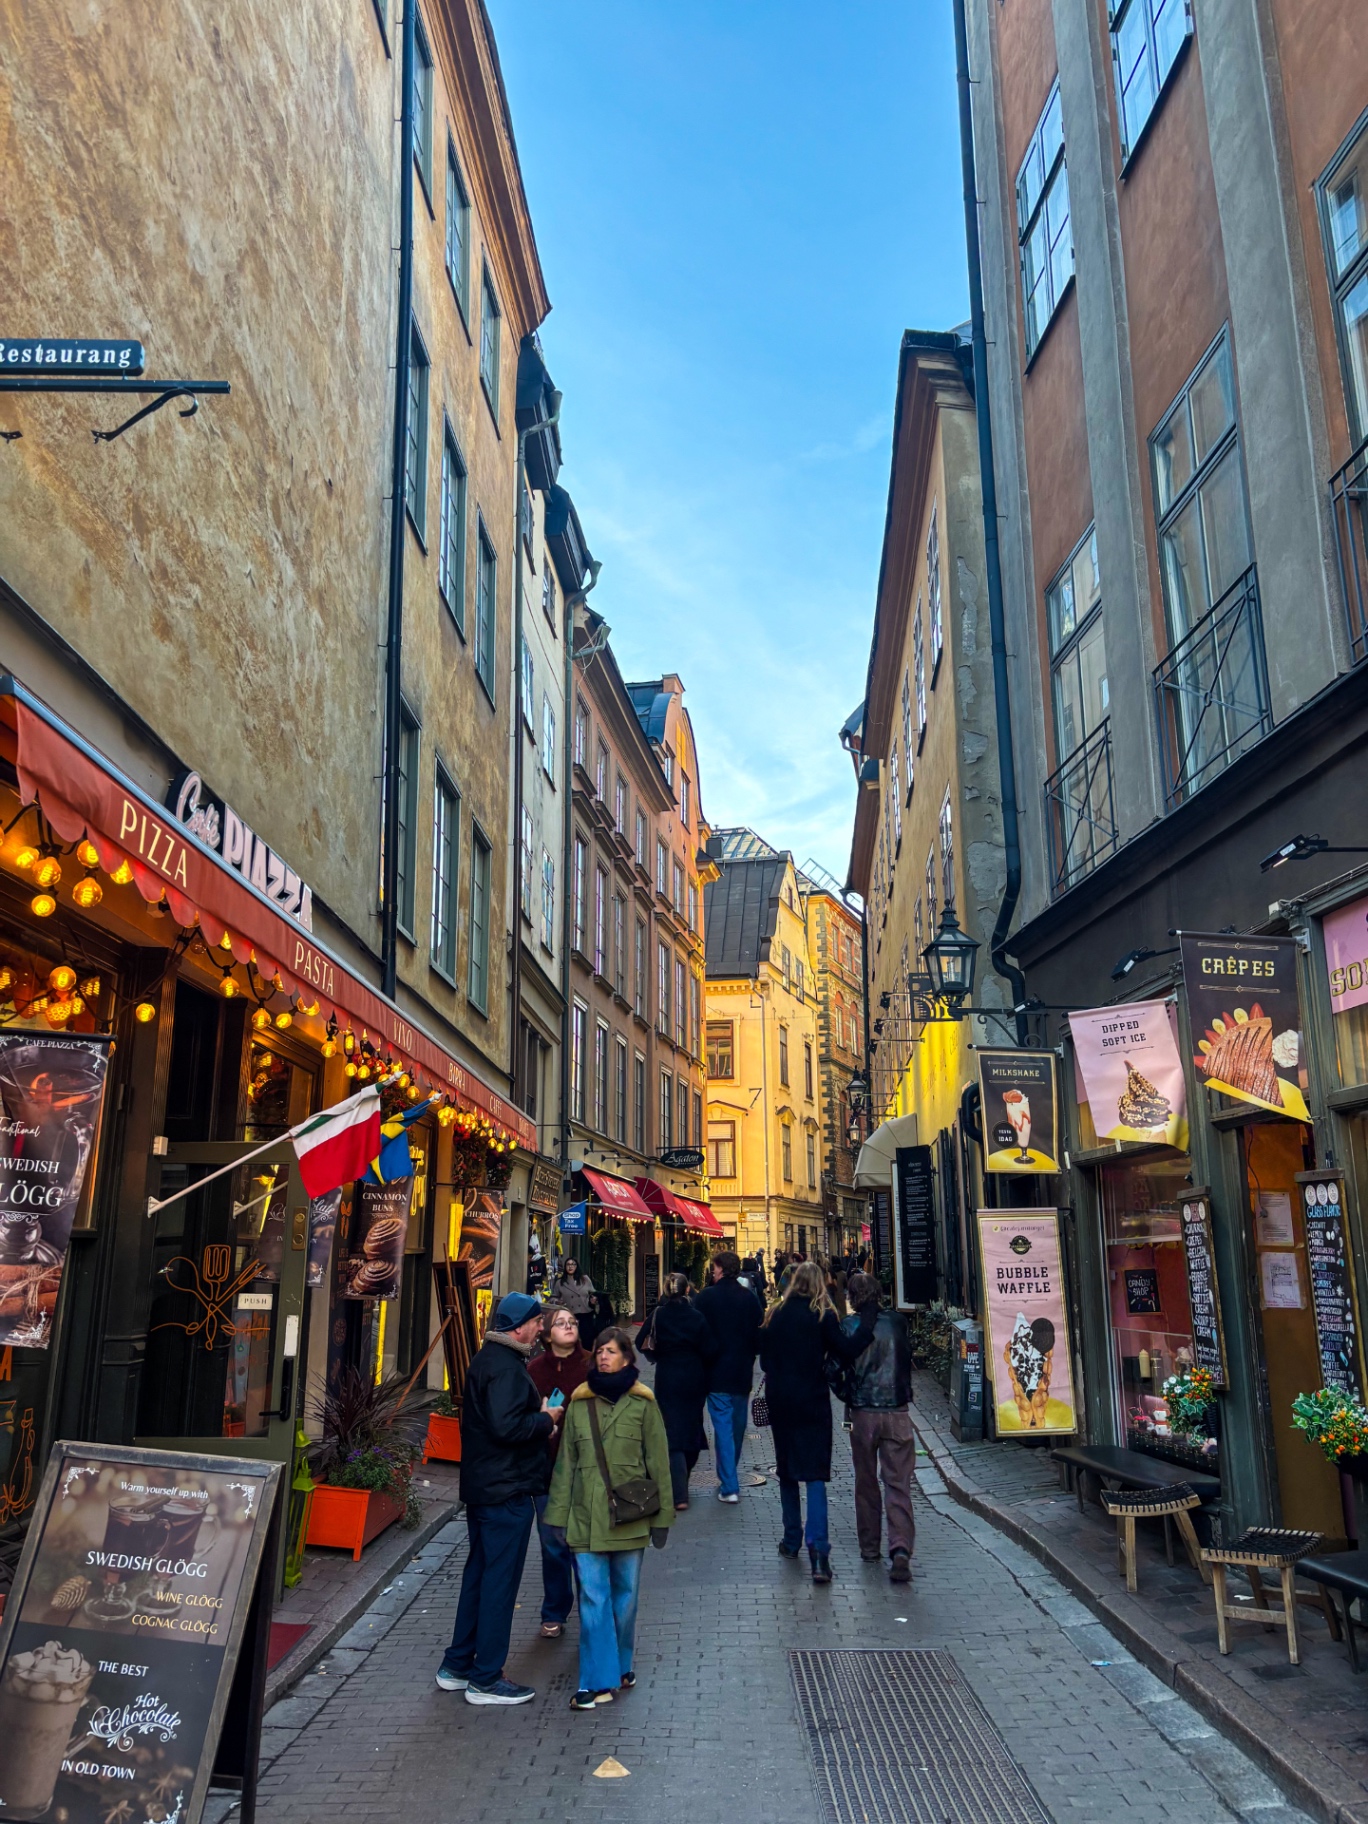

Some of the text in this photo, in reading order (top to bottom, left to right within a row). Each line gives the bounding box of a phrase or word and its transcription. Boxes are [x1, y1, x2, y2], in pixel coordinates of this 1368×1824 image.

[119, 799, 187, 888] PIZZA
[222, 803, 313, 933] PIAZZA
[294, 940, 335, 996] PASTA
[1201, 955, 1275, 977] CRÊPES
[1329, 957, 1368, 998] SO
[393, 1017, 413, 1052] VINO
[1101, 1020, 1139, 1034] DIPPED
[47, 1041, 74, 1050] PIAZZA
[1102, 1033, 1147, 1047] SOFT ICE
[448, 1062, 466, 1092] BIRRA
[992, 1068, 1040, 1077] MILKSHAKE
[664, 1152, 699, 1166] Agaton
[362, 1192, 407, 1202] CINNAMON
[372, 1204, 394, 1212] BUNS
[464, 1210, 499, 1221] CHURROS
[996, 1266, 1049, 1279] BUBBLE
[997, 1281, 1051, 1294] WAFFLE
[1128, 1278, 1151, 1288] CANDY
[120, 1481, 208, 1499] Warm yourself up with
[86, 1550, 208, 1578] SWEDISH GLÖGG
[156, 1591, 223, 1609] WINE GLÖGG
[131, 1614, 218, 1635] COGNAC GLÖGG
[98, 1660, 149, 1677] THE BEST
[133, 1692, 160, 1709] Hot
[90, 1702, 182, 1736] Chocolate
[61, 1759, 136, 1780] IN OLD TOWN
